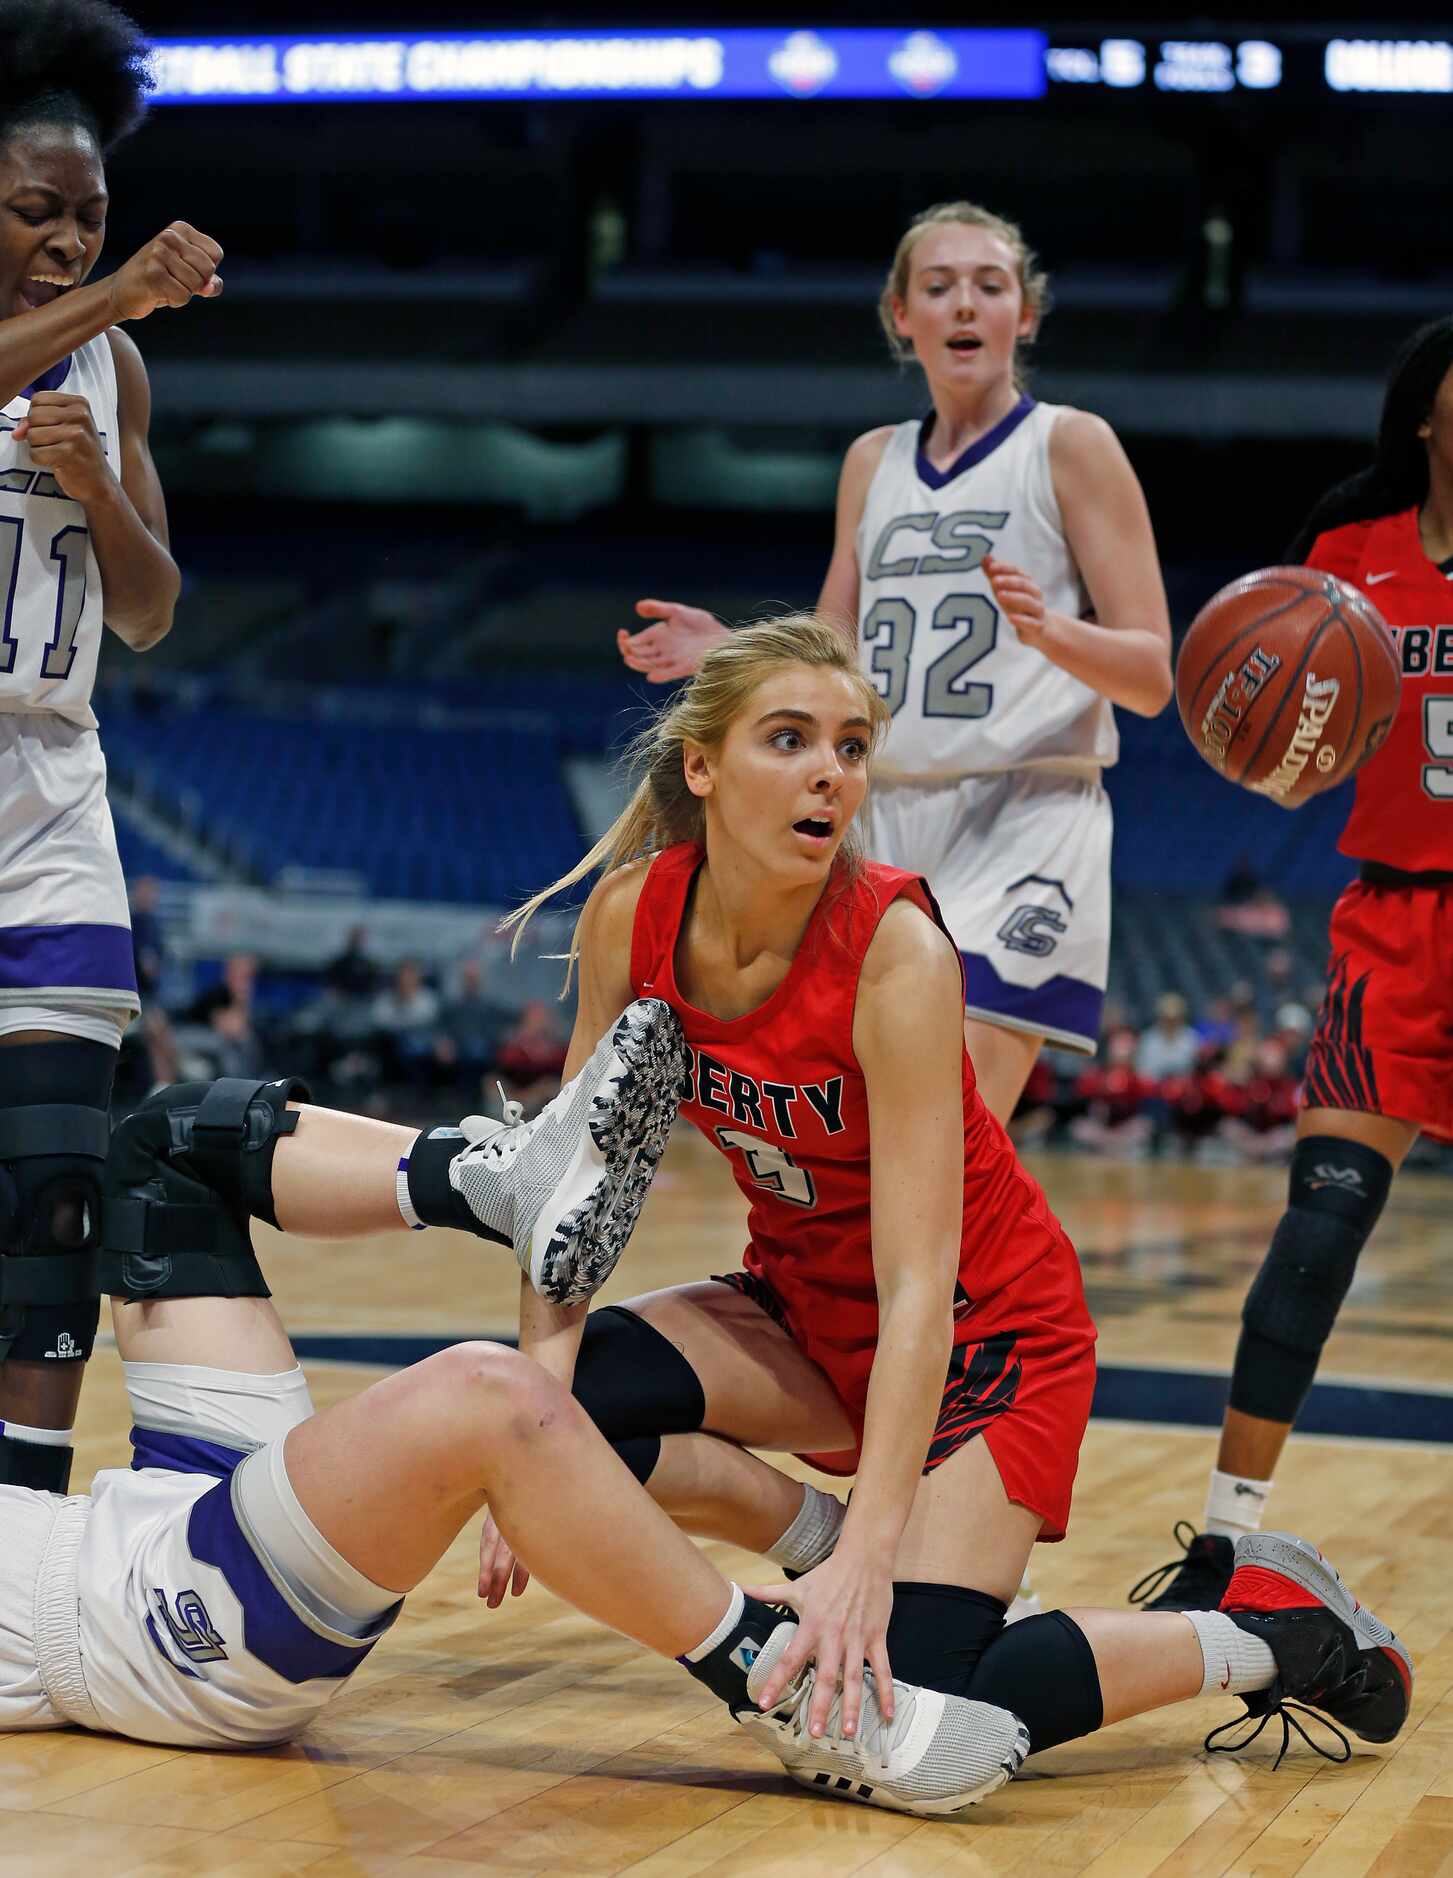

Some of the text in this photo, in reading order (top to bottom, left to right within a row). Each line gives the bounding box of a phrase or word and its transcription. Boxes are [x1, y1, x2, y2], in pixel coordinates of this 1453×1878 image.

[866, 510, 1010, 581] CS
[863, 593, 999, 719] 32
[714, 1125, 817, 1209] 3
